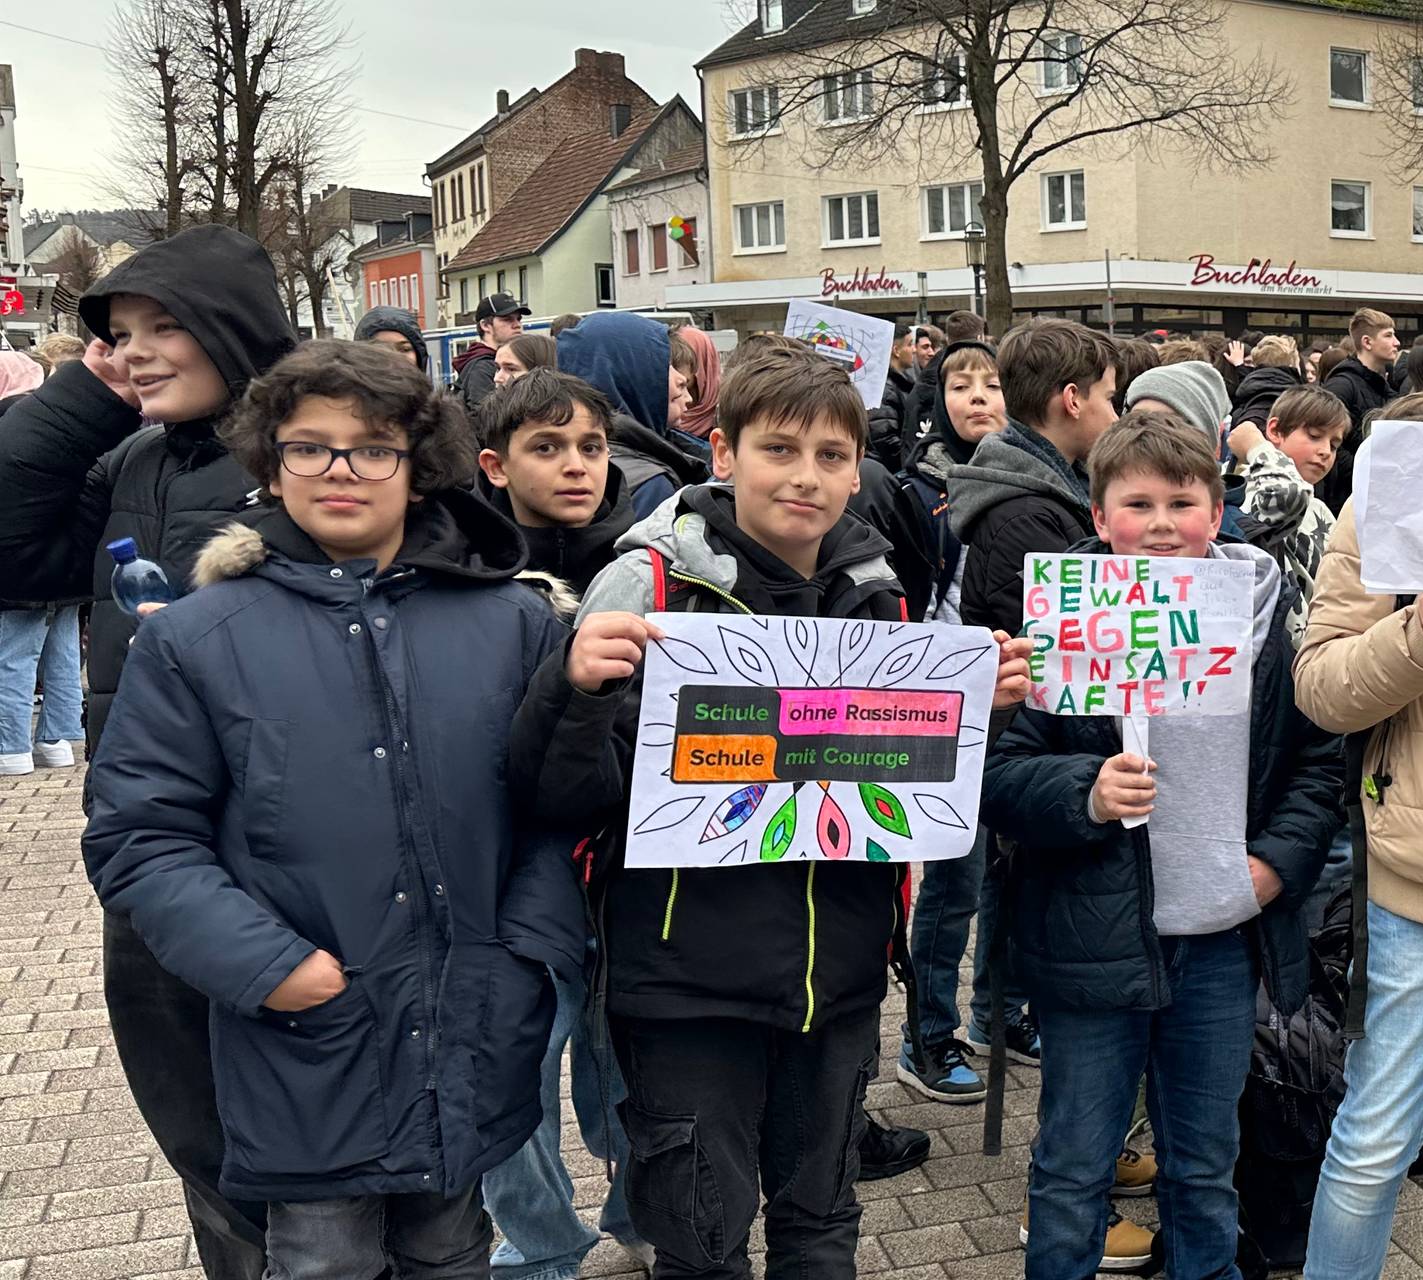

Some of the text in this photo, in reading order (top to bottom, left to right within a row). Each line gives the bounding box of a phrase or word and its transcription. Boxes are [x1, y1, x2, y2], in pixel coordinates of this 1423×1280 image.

[820, 265, 903, 296] Buchladen
[1188, 254, 1321, 287] Buchladen
[1305, 285, 1332, 295] markt
[1033, 558, 1151, 585] KEINE
[1026, 575, 1194, 618] GEWALT
[1029, 646, 1237, 683] EINSATZ
[694, 703, 948, 723] Schule ohne Rassismus
[690, 747, 909, 771] Schule mit Courage
